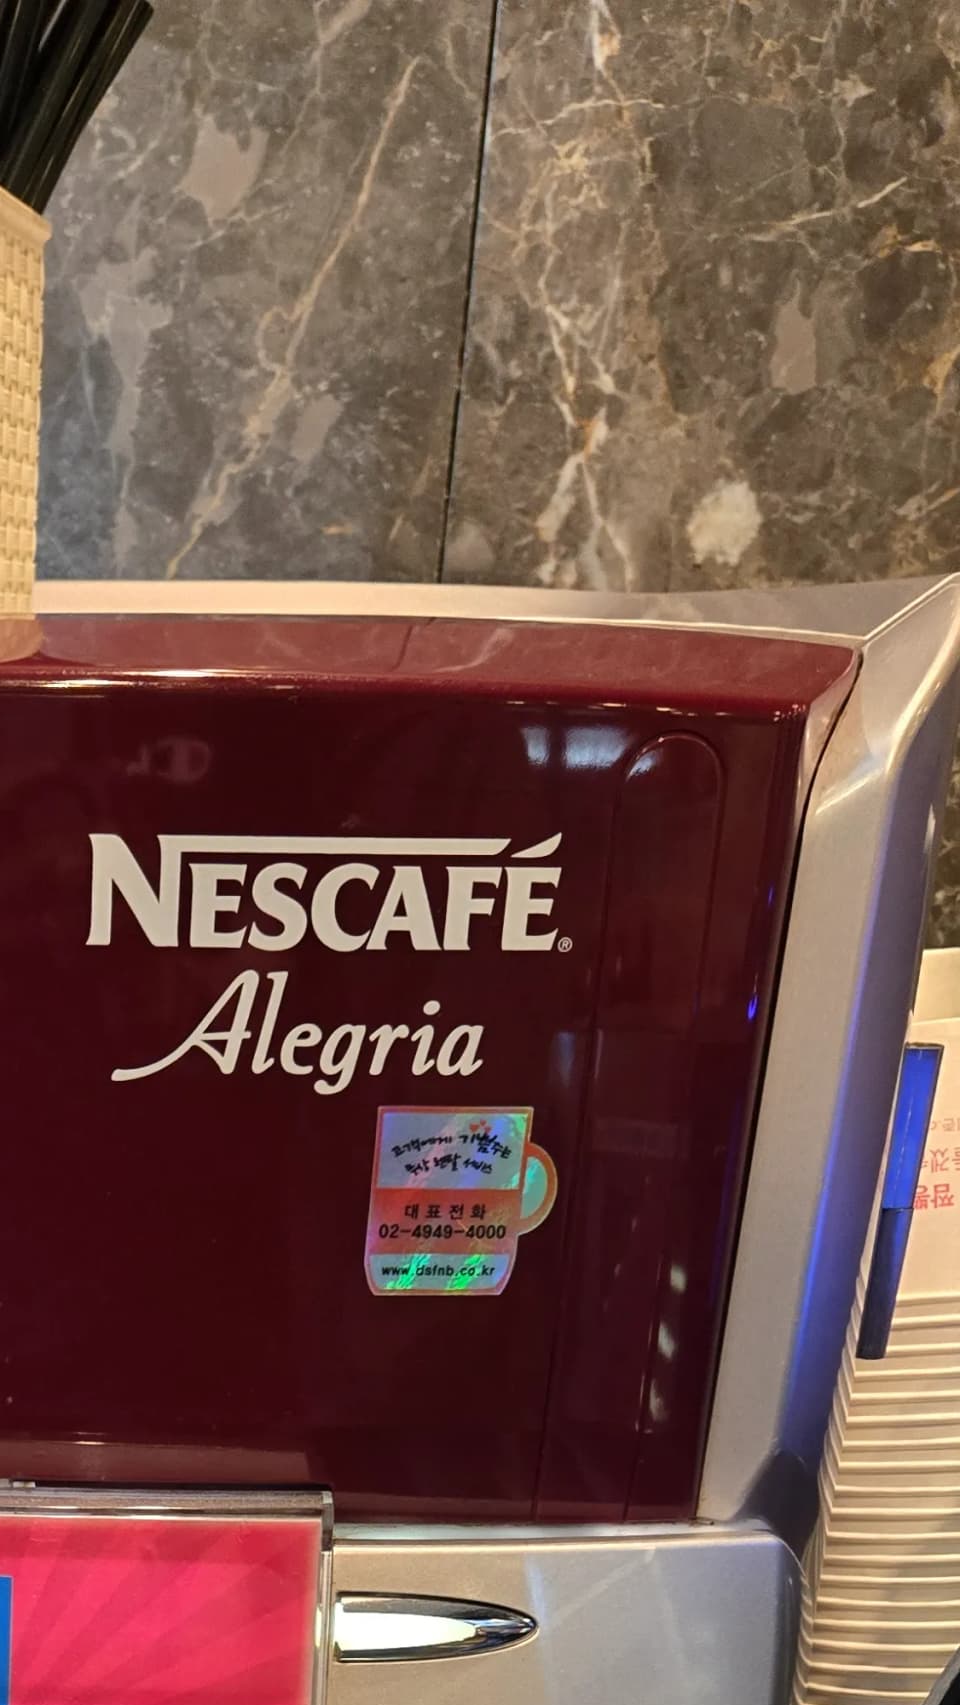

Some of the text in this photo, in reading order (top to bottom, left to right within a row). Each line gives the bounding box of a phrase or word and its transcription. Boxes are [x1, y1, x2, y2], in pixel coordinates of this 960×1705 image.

[85, 832, 563, 952] NESCAFÉ
[111, 969, 484, 1094] Alegria
[379, 1224, 506, 1239] 02-4949-4000
[382, 1263, 495, 1276] www.dsfnb.co.kr
